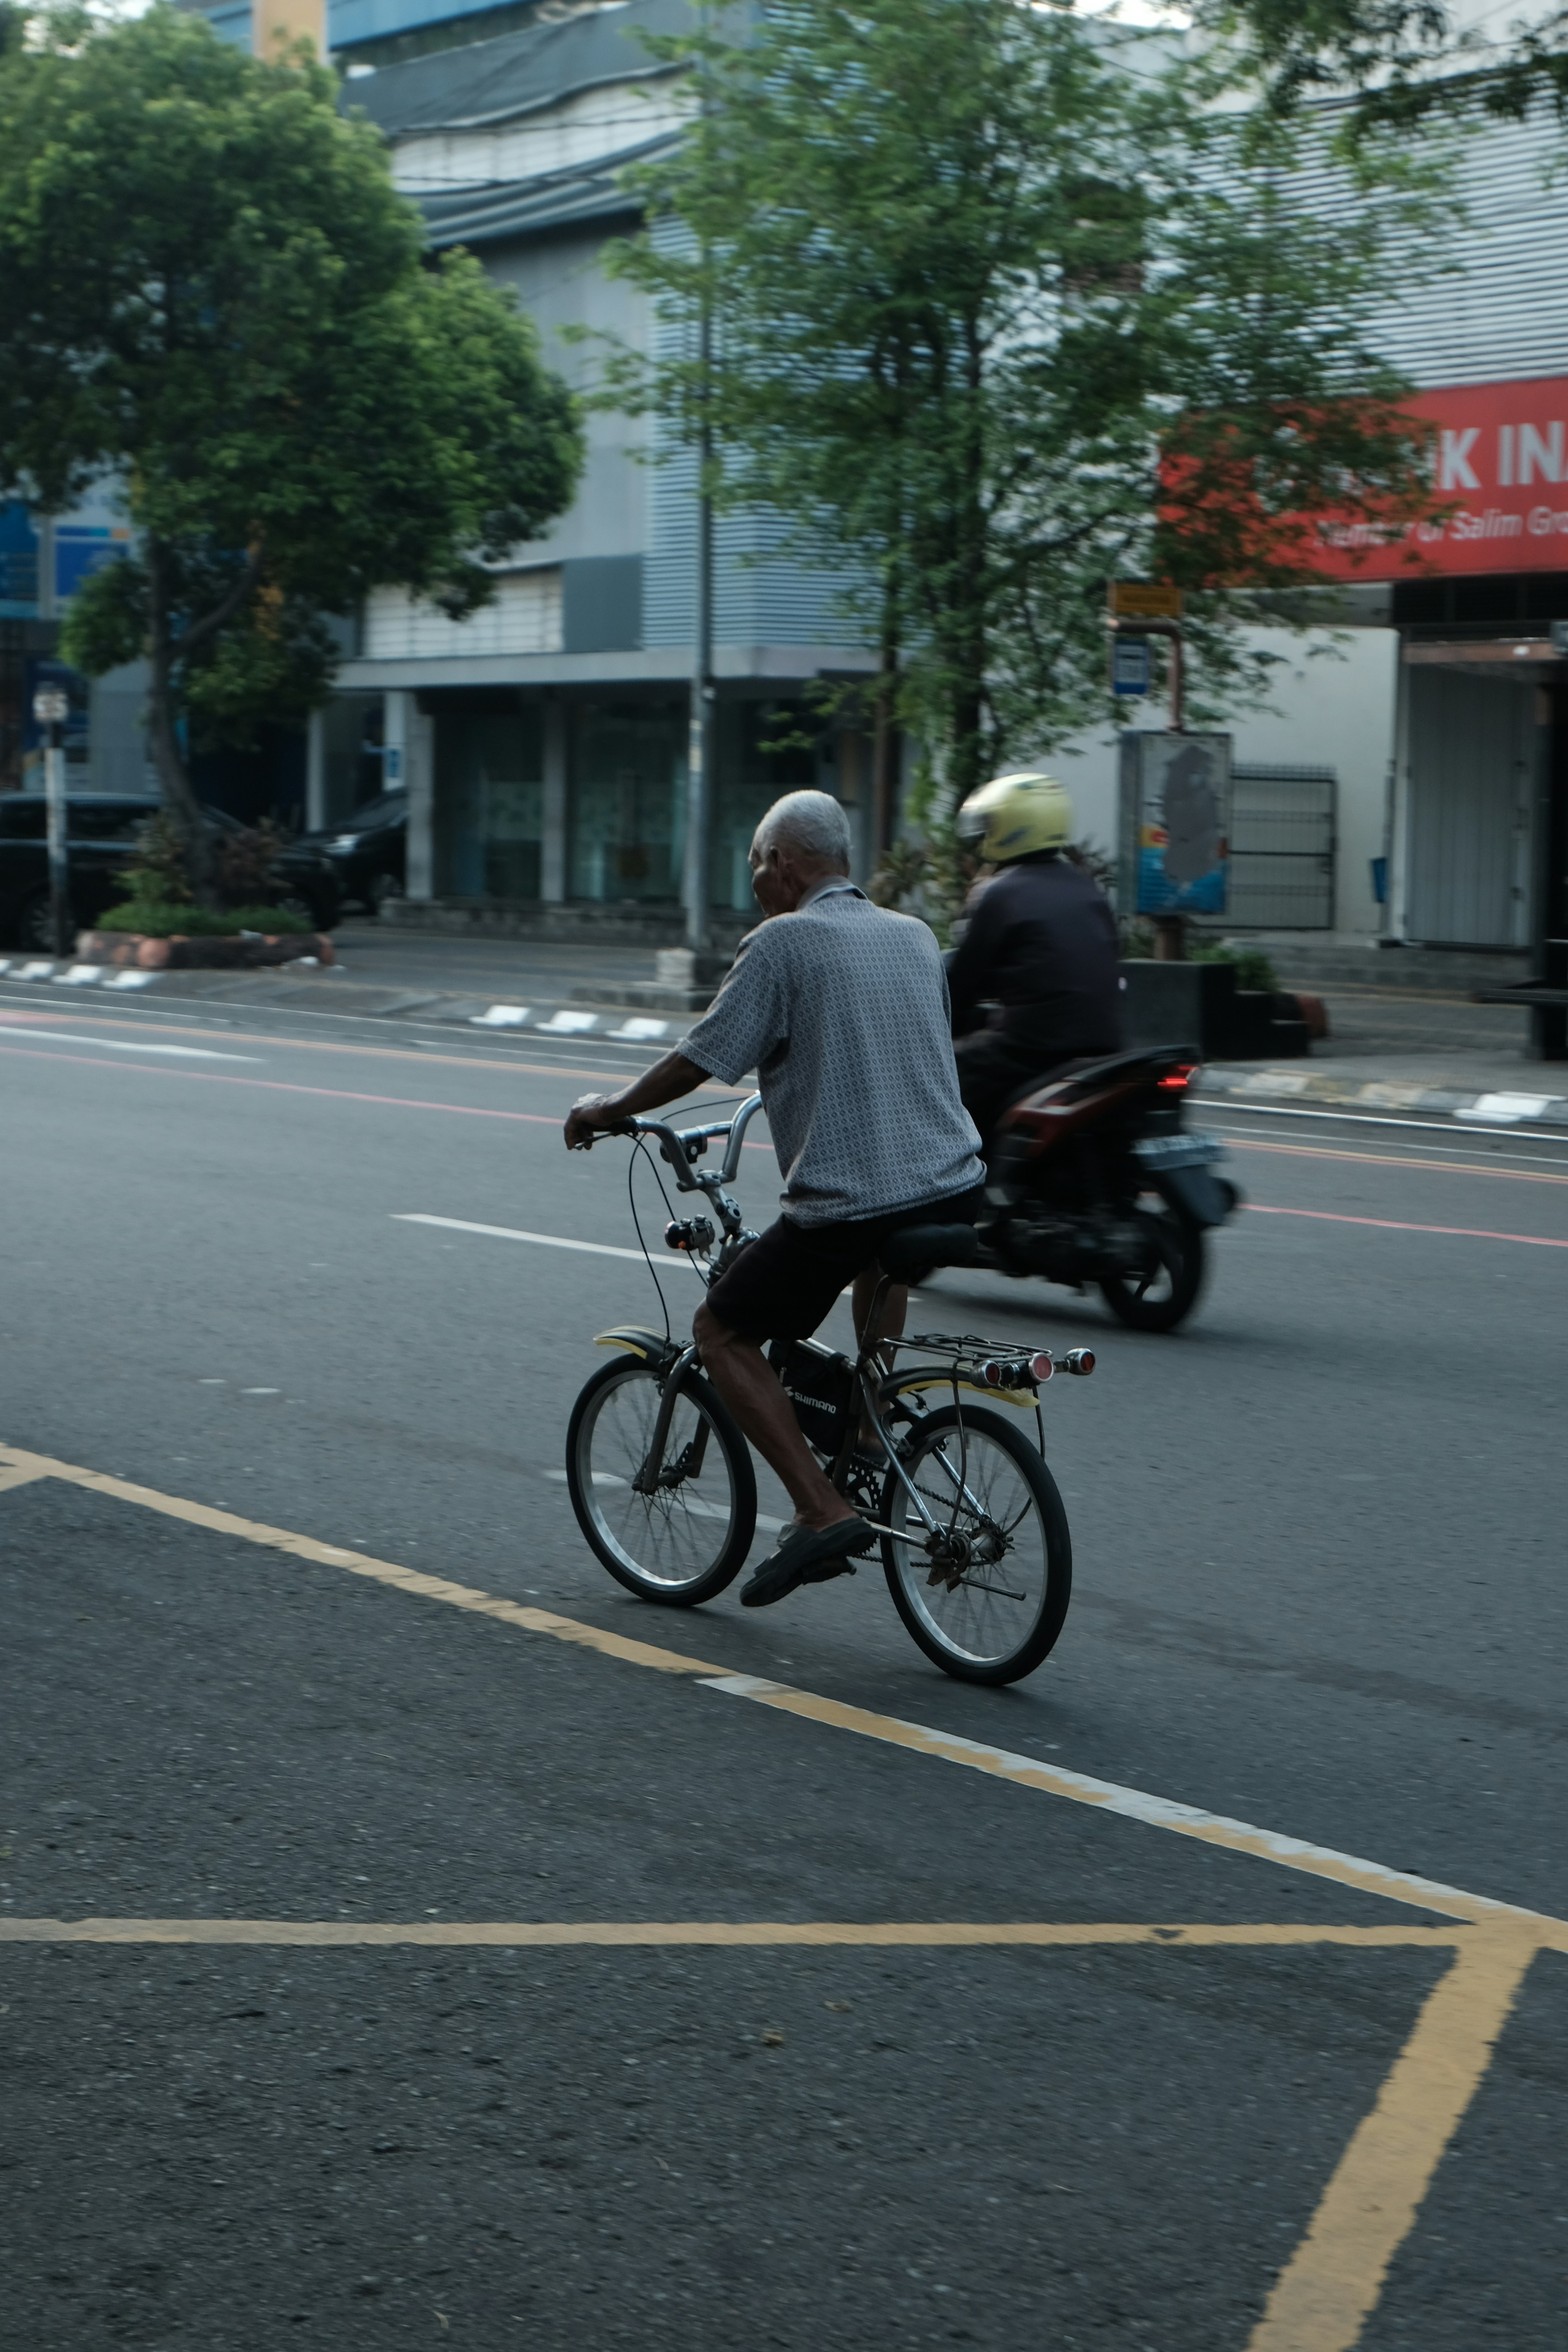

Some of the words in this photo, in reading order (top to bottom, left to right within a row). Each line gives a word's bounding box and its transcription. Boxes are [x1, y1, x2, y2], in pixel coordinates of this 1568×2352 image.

[1498, 420, 1568, 486] IN
[1450, 508, 1523, 541] Salim
[794, 1391, 836, 1414] SHIMANO
